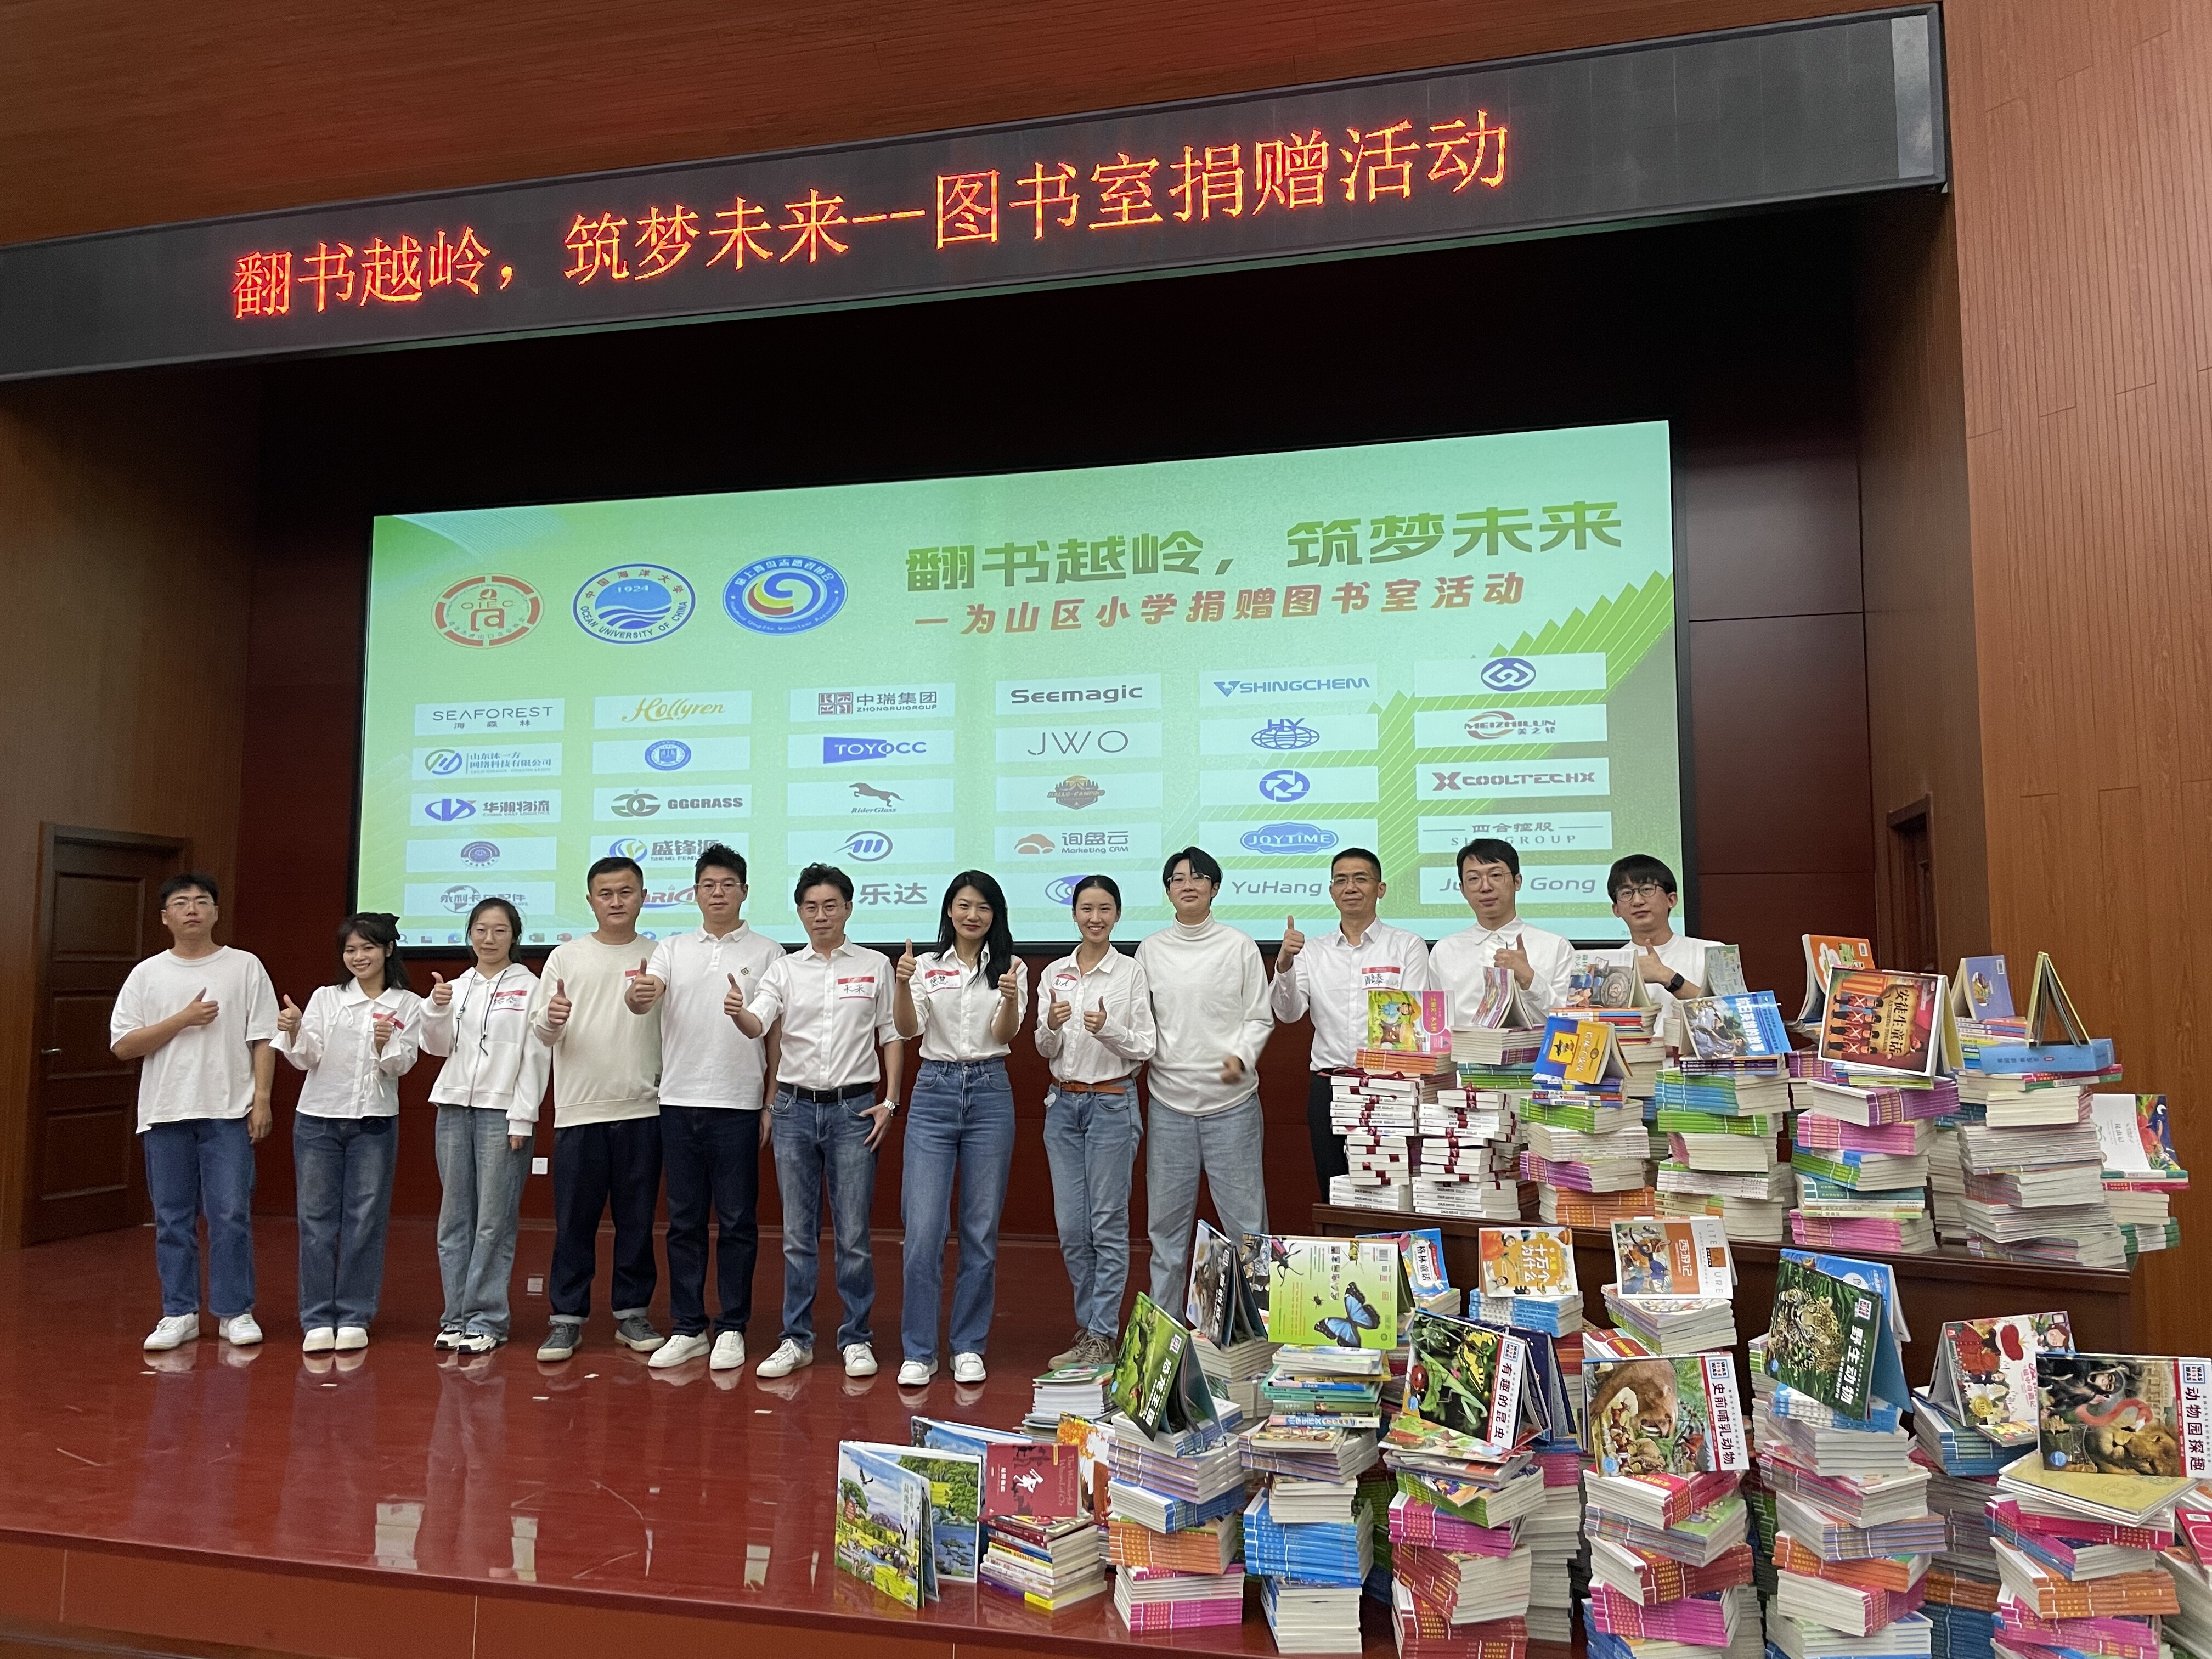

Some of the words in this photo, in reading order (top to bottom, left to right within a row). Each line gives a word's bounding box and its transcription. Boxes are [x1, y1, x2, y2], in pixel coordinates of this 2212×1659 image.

[232, 226, 514, 319] 翻书越岭，
[905, 530, 1234, 591] 翻书越岭，
[1287, 500, 1622, 567] 筑梦未来
[617, 585, 649, 593] 1924
[580, 606, 599, 628] OCEAN
[599, 626, 653, 639] UNIVERSITY
[658, 622, 670, 631] OF
[672, 601, 688, 622] CHINA
[1011, 684, 1143, 704] Seemagic
[1239, 677, 1370, 694] SHINGCHEM
[856, 691, 937, 706] 中瑞集团
[857, 704, 937, 712] ZHONGRUIGROUP
[432, 707, 554, 721] SEAFOREST
[621, 697, 726, 723] Hollyren
[1267, 718, 1305, 732] HY
[1464, 719, 1556, 730] MEIZHILUN
[834, 741, 927, 755] TOYOCC
[1027, 730, 1129, 755] JWO
[1462, 772, 1595, 786] COOLTECHX
[1062, 831, 1129, 846] 询盘云
[1247, 833, 1331, 845] JOYTIME
[1231, 881, 1322, 896] YuHang
[1530, 877, 1596, 893] Gong
[1889, 989, 1910, 1054] 安徒生童话
[1417, 1246, 1431, 1281] 格林童话
[1521, 1244, 1537, 1283] 为什么
[1534, 1243, 1550, 1283] 十万个
[1679, 1239, 1692, 1277] 西游记
[1841, 1325, 1864, 1405] 野生动物
[1494, 1363, 1513, 1439] 有趣的昆虫
[1712, 1382, 1735, 1464] 史前哺乳动物
[2185, 1386, 2205, 1471] 动物园探趣
